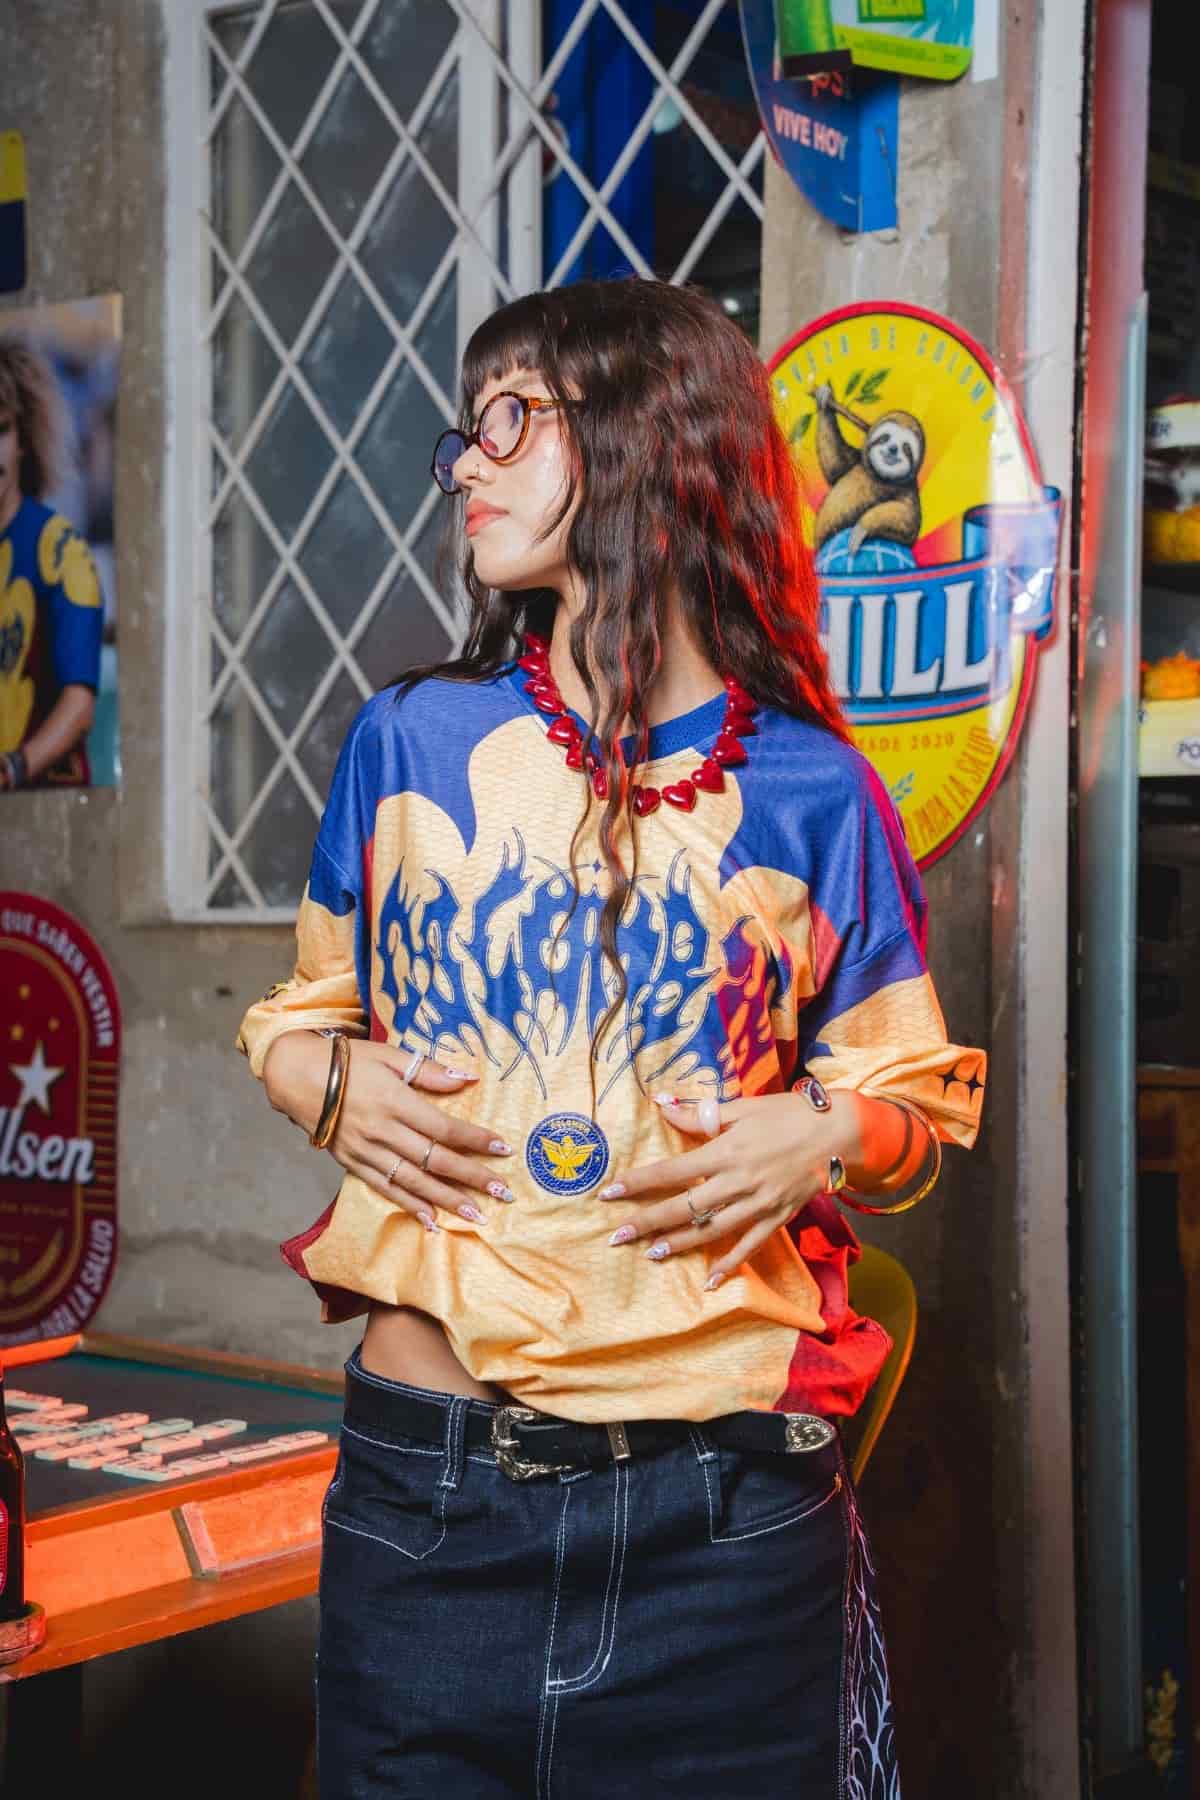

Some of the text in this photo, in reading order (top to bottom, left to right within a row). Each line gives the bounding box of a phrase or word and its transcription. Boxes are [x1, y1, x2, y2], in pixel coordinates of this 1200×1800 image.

[773, 104, 848, 160] VIVE HOY
[870, 325, 896, 351] DE
[956, 725, 995, 784] SALUD
[941, 775, 974, 811] LA
[1, 910, 36, 935] QUE
[37, 920, 88, 975] SABEN
[80, 1218, 114, 1292] SALUD
[68, 1284, 95, 1320] LA
